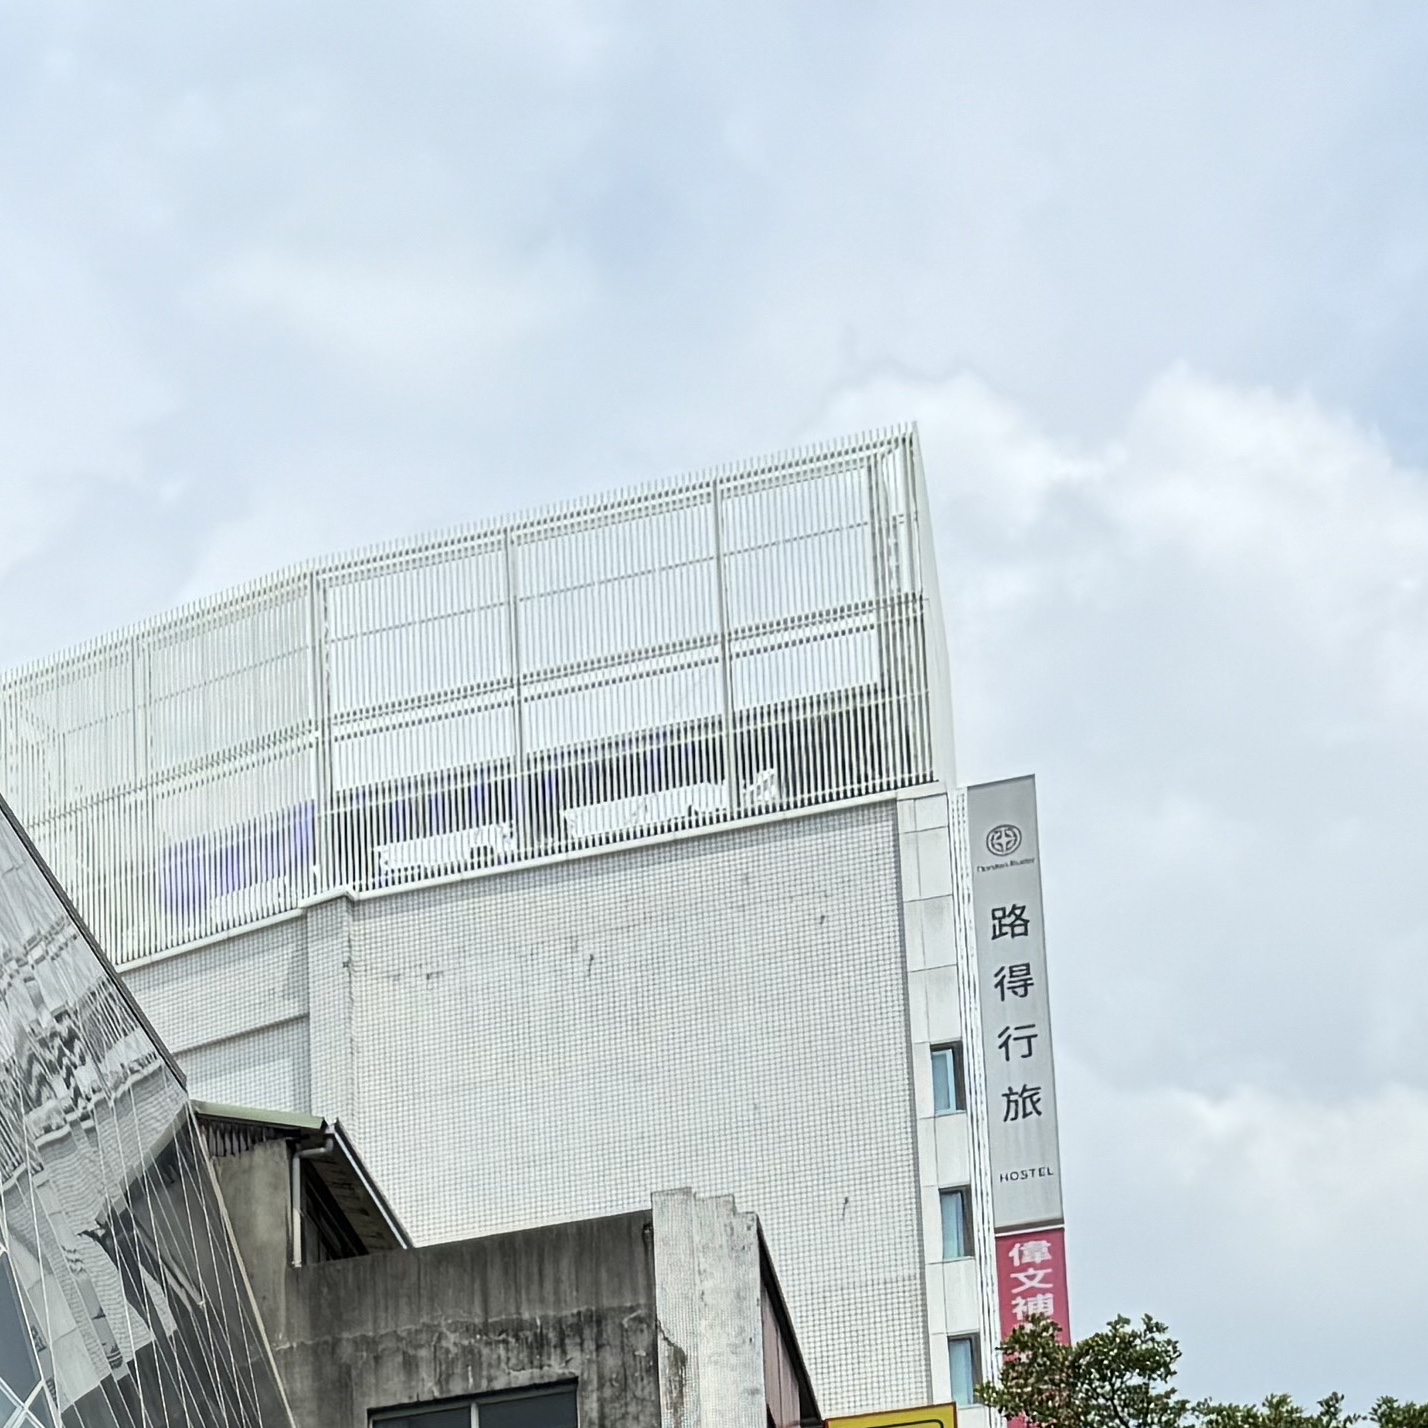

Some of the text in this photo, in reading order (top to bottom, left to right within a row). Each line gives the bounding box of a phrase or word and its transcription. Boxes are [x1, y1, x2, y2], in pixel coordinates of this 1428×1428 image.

[991, 903, 1043, 1122] 路得行旅
[999, 1166, 1054, 1183] HOSTEL
